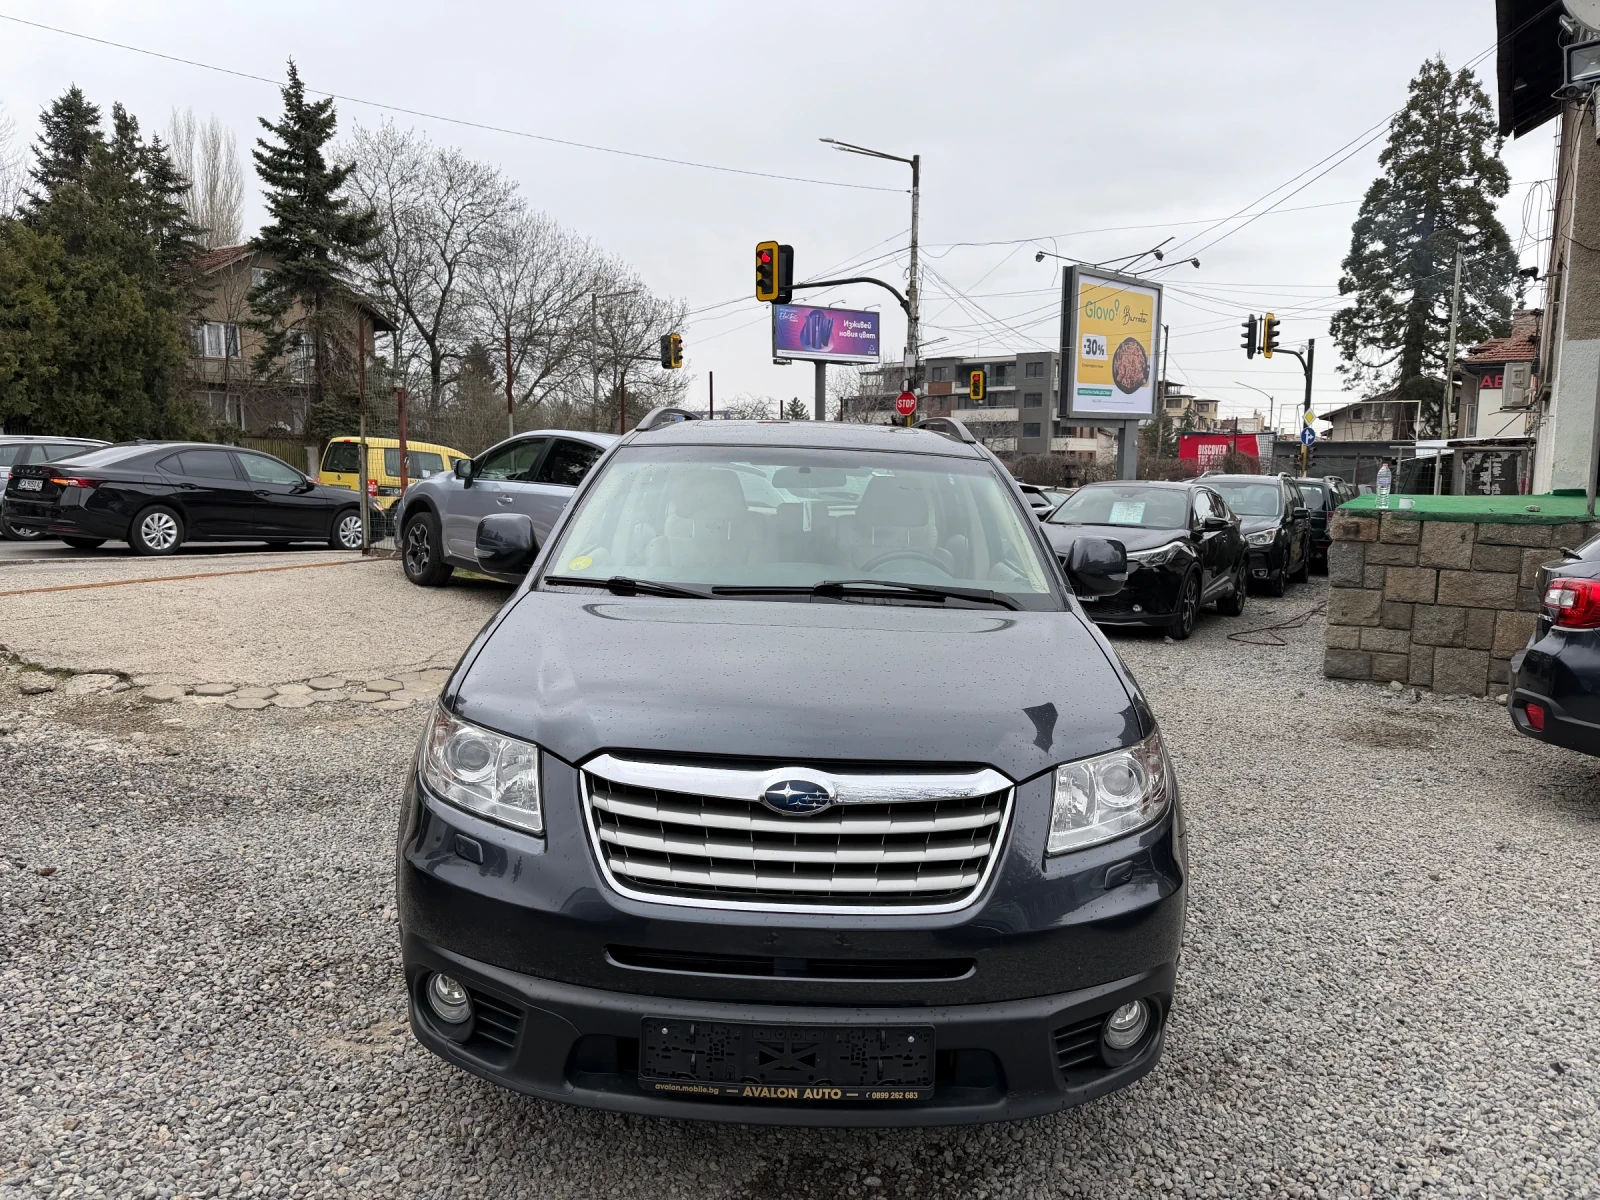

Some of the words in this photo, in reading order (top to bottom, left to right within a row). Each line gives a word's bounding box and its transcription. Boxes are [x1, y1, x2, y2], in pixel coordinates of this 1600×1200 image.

[1086, 300, 1115, 321] Glovo
[843, 319, 872, 329] Изживей
[839, 330, 858, 338] новия
[859, 330, 876, 339] цвят
[1084, 338, 1104, 355] -30%
[898, 399, 915, 408] STOP
[1198, 444, 1227, 455] DISCOVER
[655, 1083, 719, 1095] avalon.mobile.bg
[743, 1086, 798, 1099] AVALON
[803, 1088, 842, 1099] AUTO
